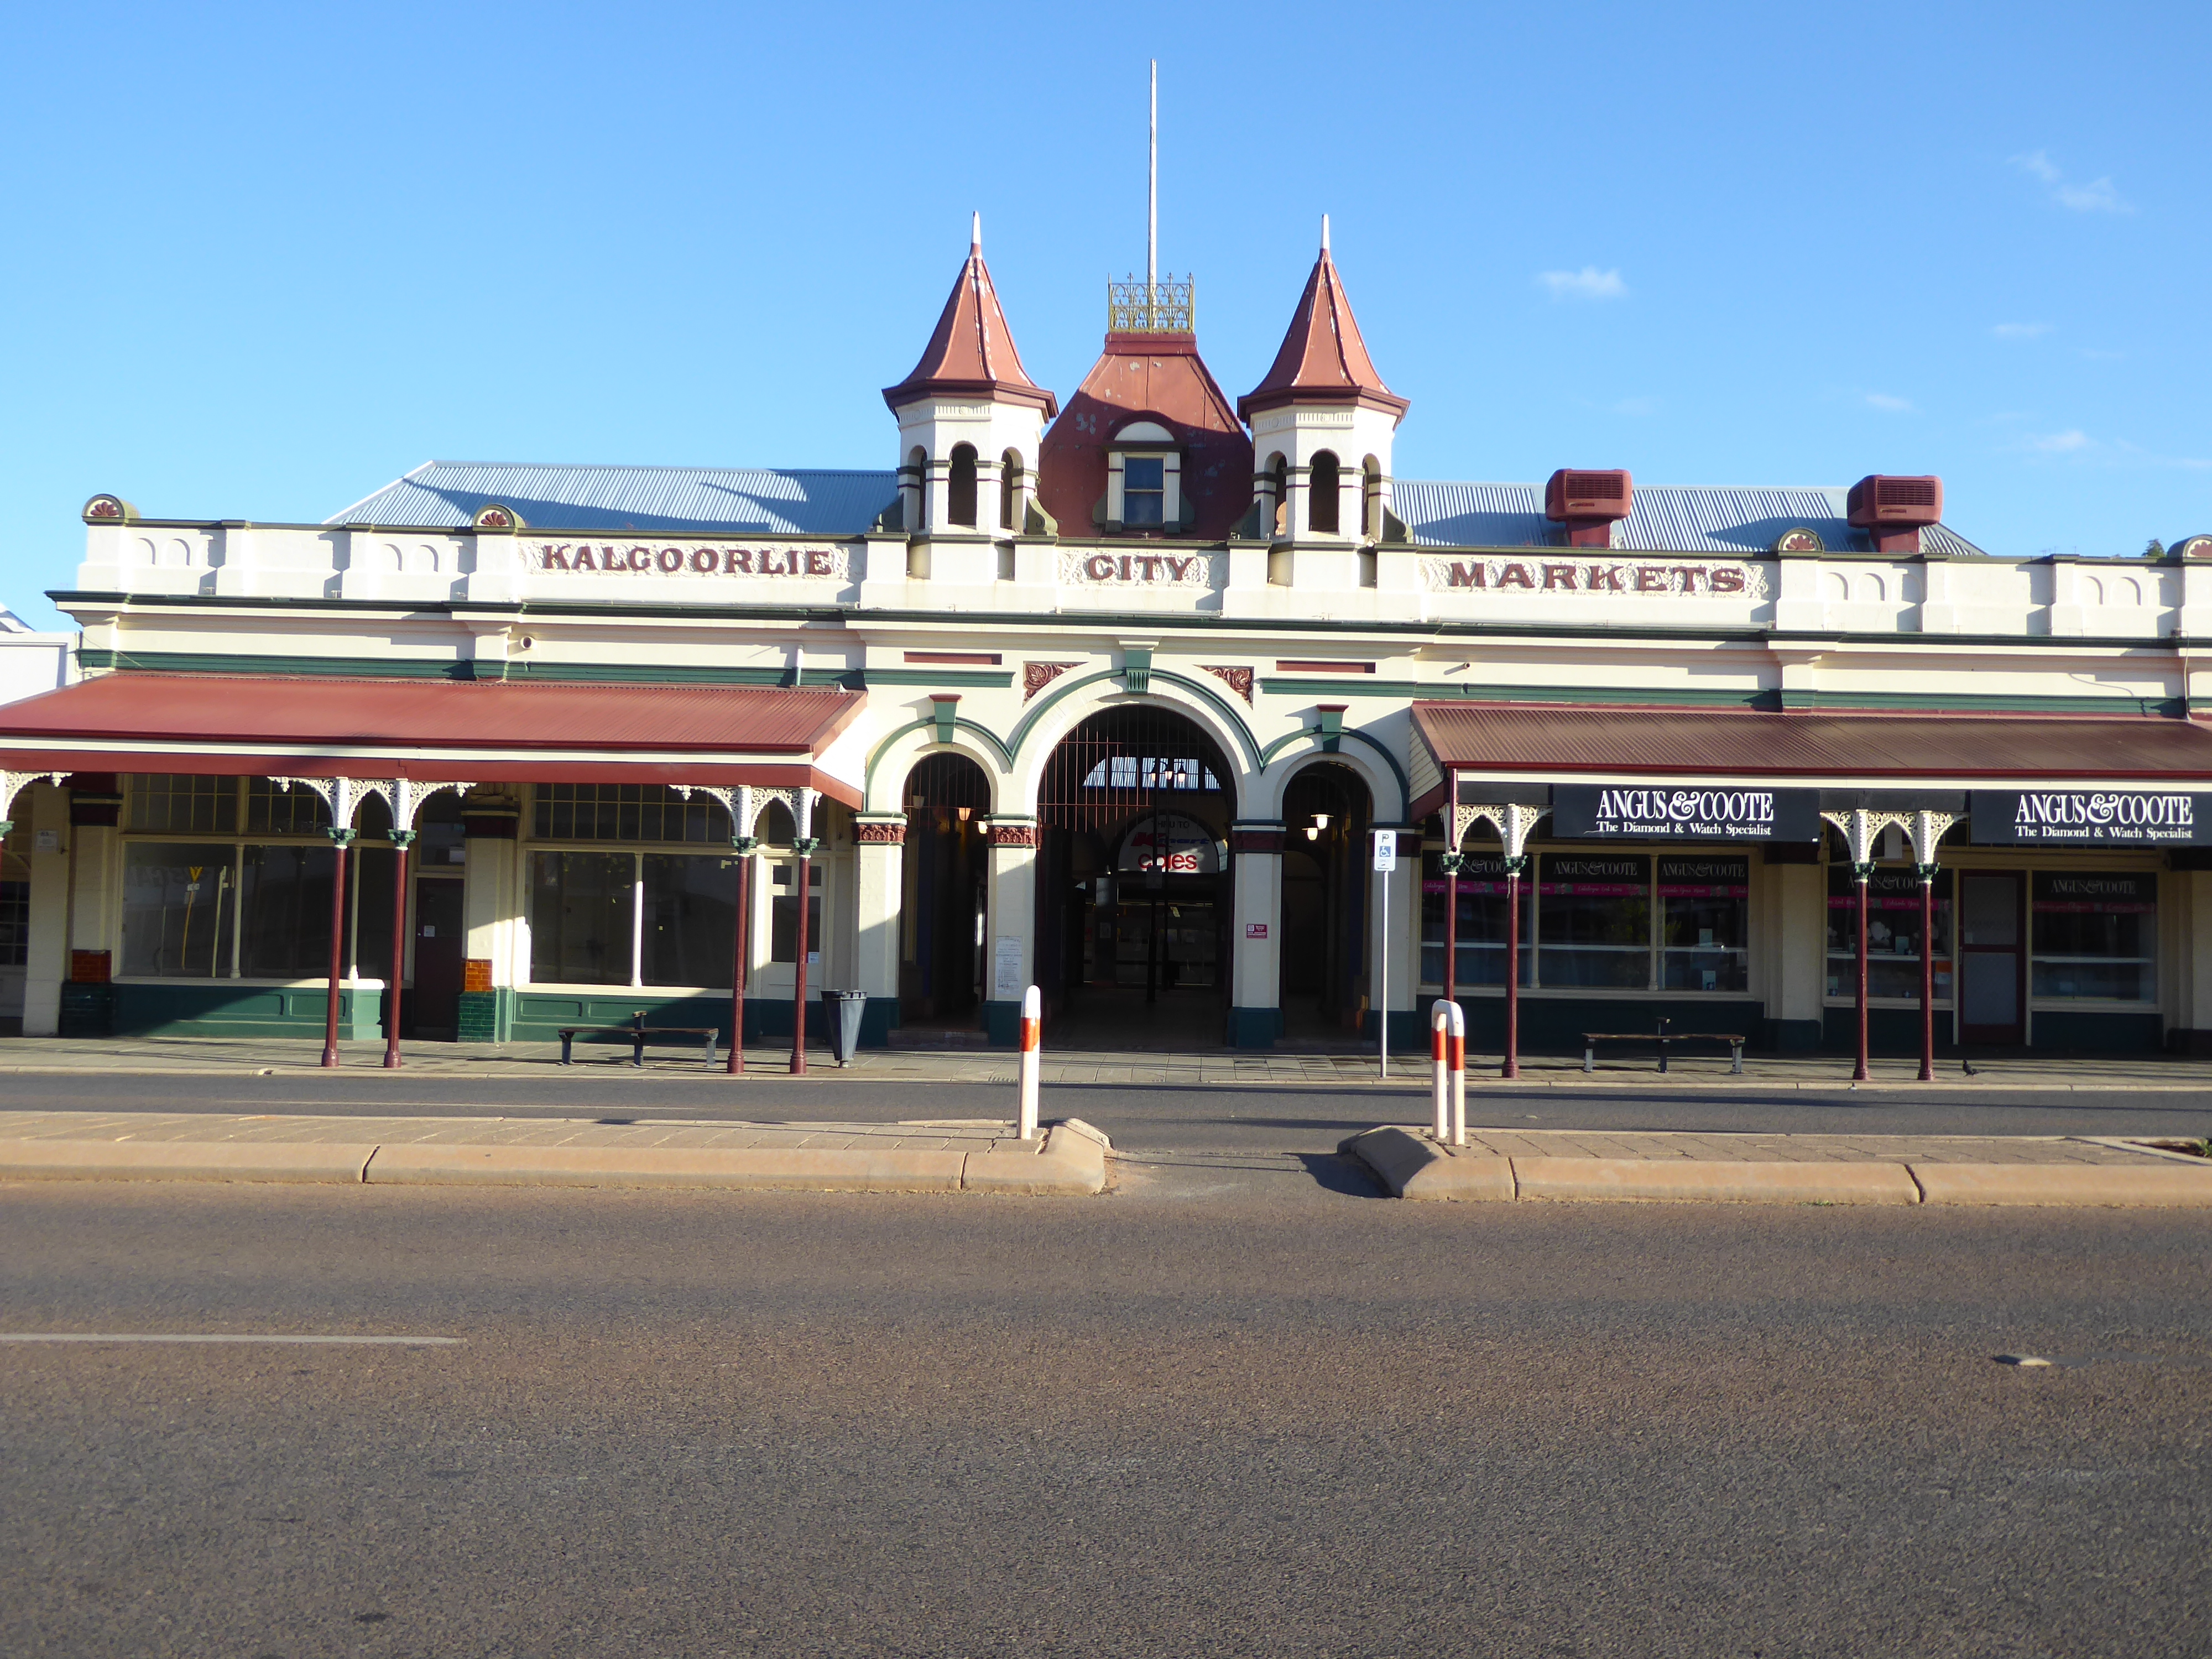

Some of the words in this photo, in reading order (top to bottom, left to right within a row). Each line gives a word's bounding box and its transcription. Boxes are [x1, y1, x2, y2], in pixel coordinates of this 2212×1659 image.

[543, 545, 832, 575] KALGOORLIE
[1088, 555, 1196, 581] CITY
[1451, 562, 1746, 593] MARKETS
[1596, 821, 1619, 832] The
[1623, 821, 1670, 833] Diamond
[1674, 822, 1684, 834] &
[1689, 822, 1721, 834] Watch
[1725, 823, 1772, 836] Specialist
[2015, 825, 2037, 837] The
[2042, 825, 2090, 838] Diamond
[2094, 826, 2104, 838] &
[2109, 827, 2142, 838] Watch
[2146, 827, 2193, 841] Specialist
